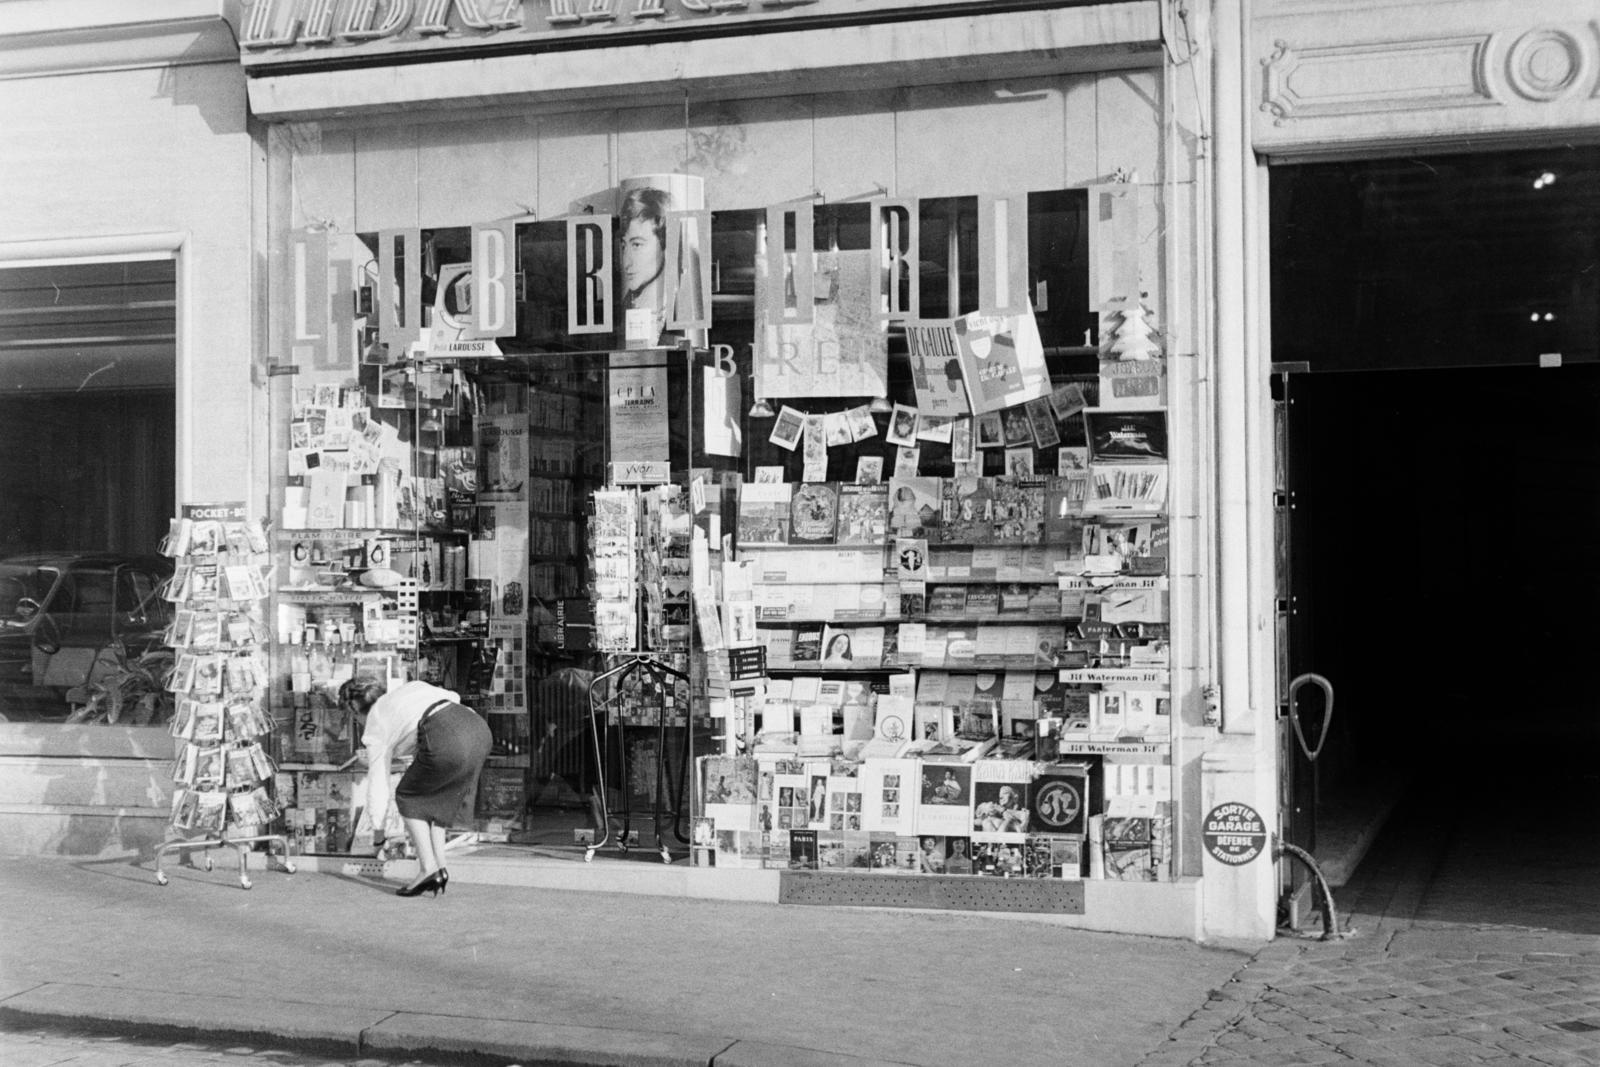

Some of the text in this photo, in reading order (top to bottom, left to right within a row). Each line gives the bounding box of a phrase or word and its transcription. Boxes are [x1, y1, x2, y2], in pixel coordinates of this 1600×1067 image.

[449, 342, 486, 352] LAROUSSE
[920, 327, 958, 357] GAULLE
[1087, 744, 1138, 752] Waterman
[1213, 804, 1256, 821] SORTIE
[1208, 821, 1260, 832] GARAGE
[1212, 846, 1257, 863] STATIONNER
